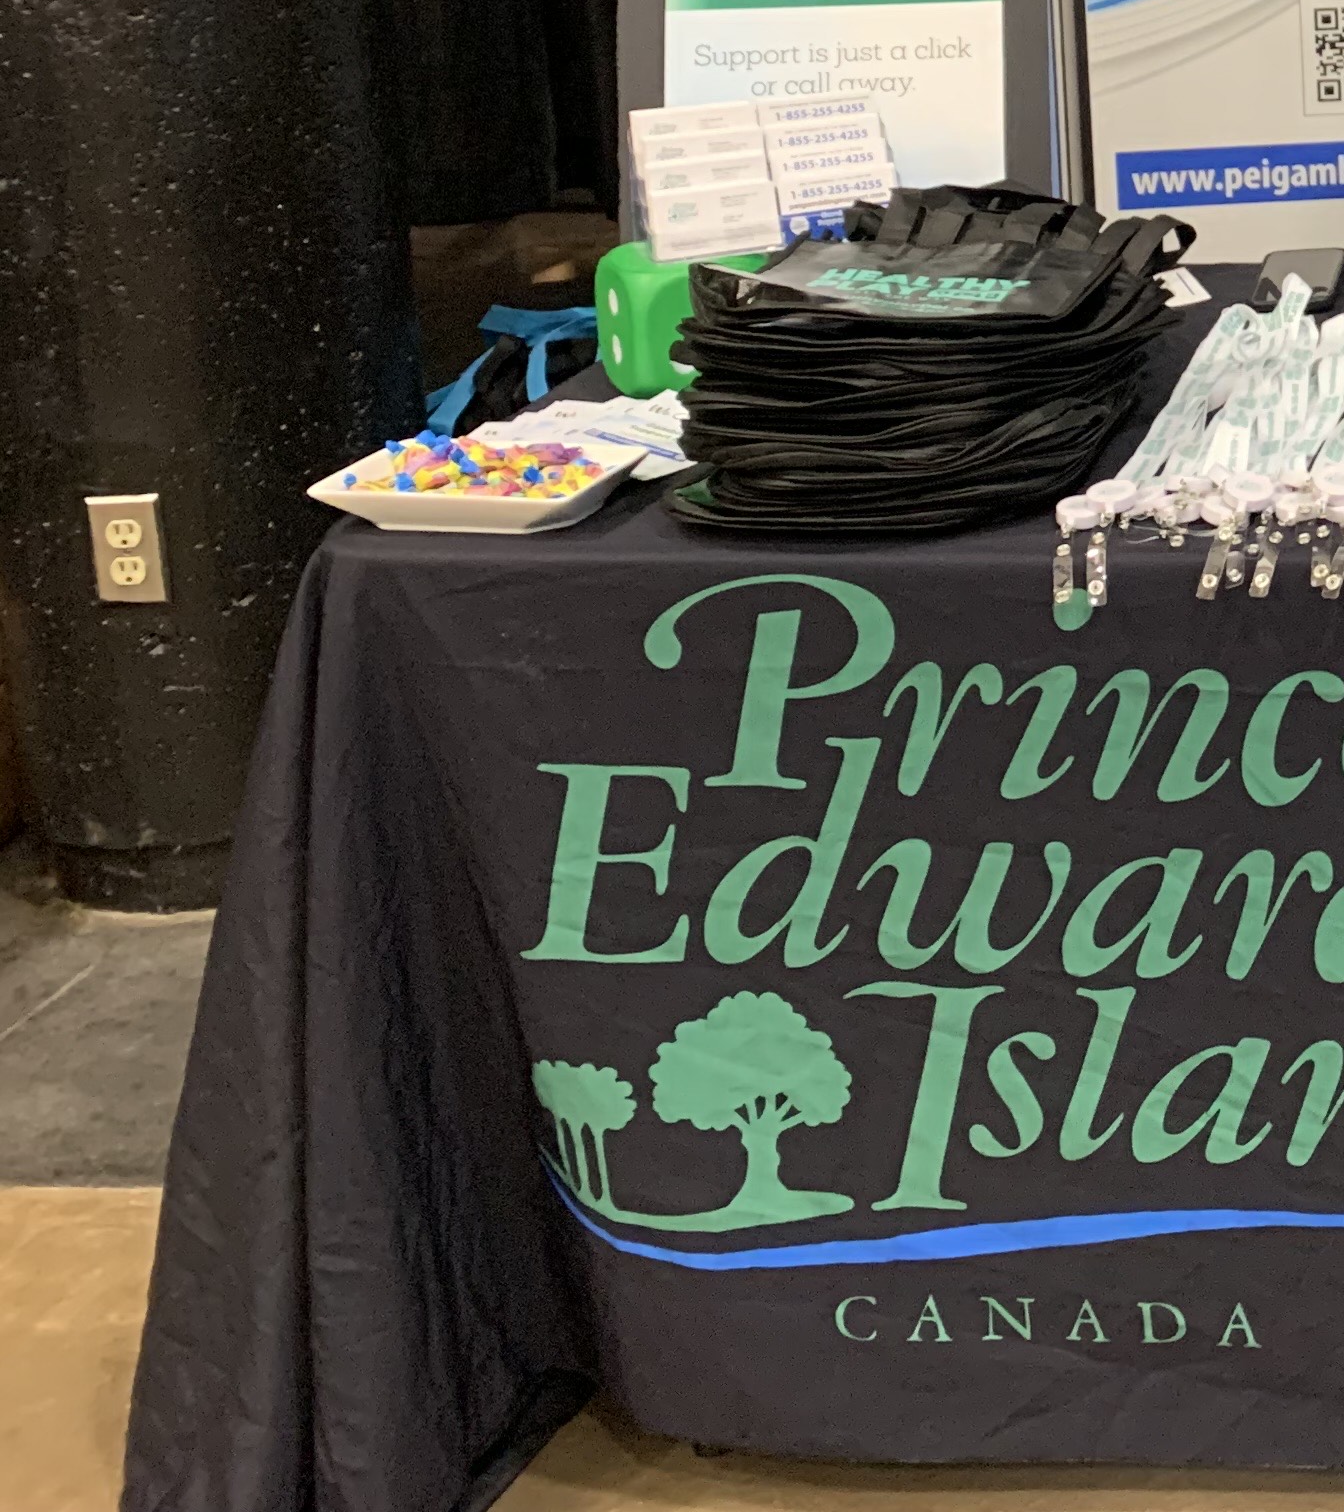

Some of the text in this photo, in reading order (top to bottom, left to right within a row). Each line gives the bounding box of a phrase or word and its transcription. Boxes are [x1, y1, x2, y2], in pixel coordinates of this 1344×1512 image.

[694, 37, 972, 70] Support is just a click
[751, 79, 776, 96] or
[784, 72, 831, 95] call
[776, 102, 866, 121] 1-855-255-4255
[778, 128, 869, 148] 1-855-255-4255
[783, 152, 874, 172] 1-855-255-4255
[790, 179, 883, 200] 1-855-255-4255
[818, 268, 1031, 292] HEALTHY
[835, 1296, 1263, 1349] CANADA
